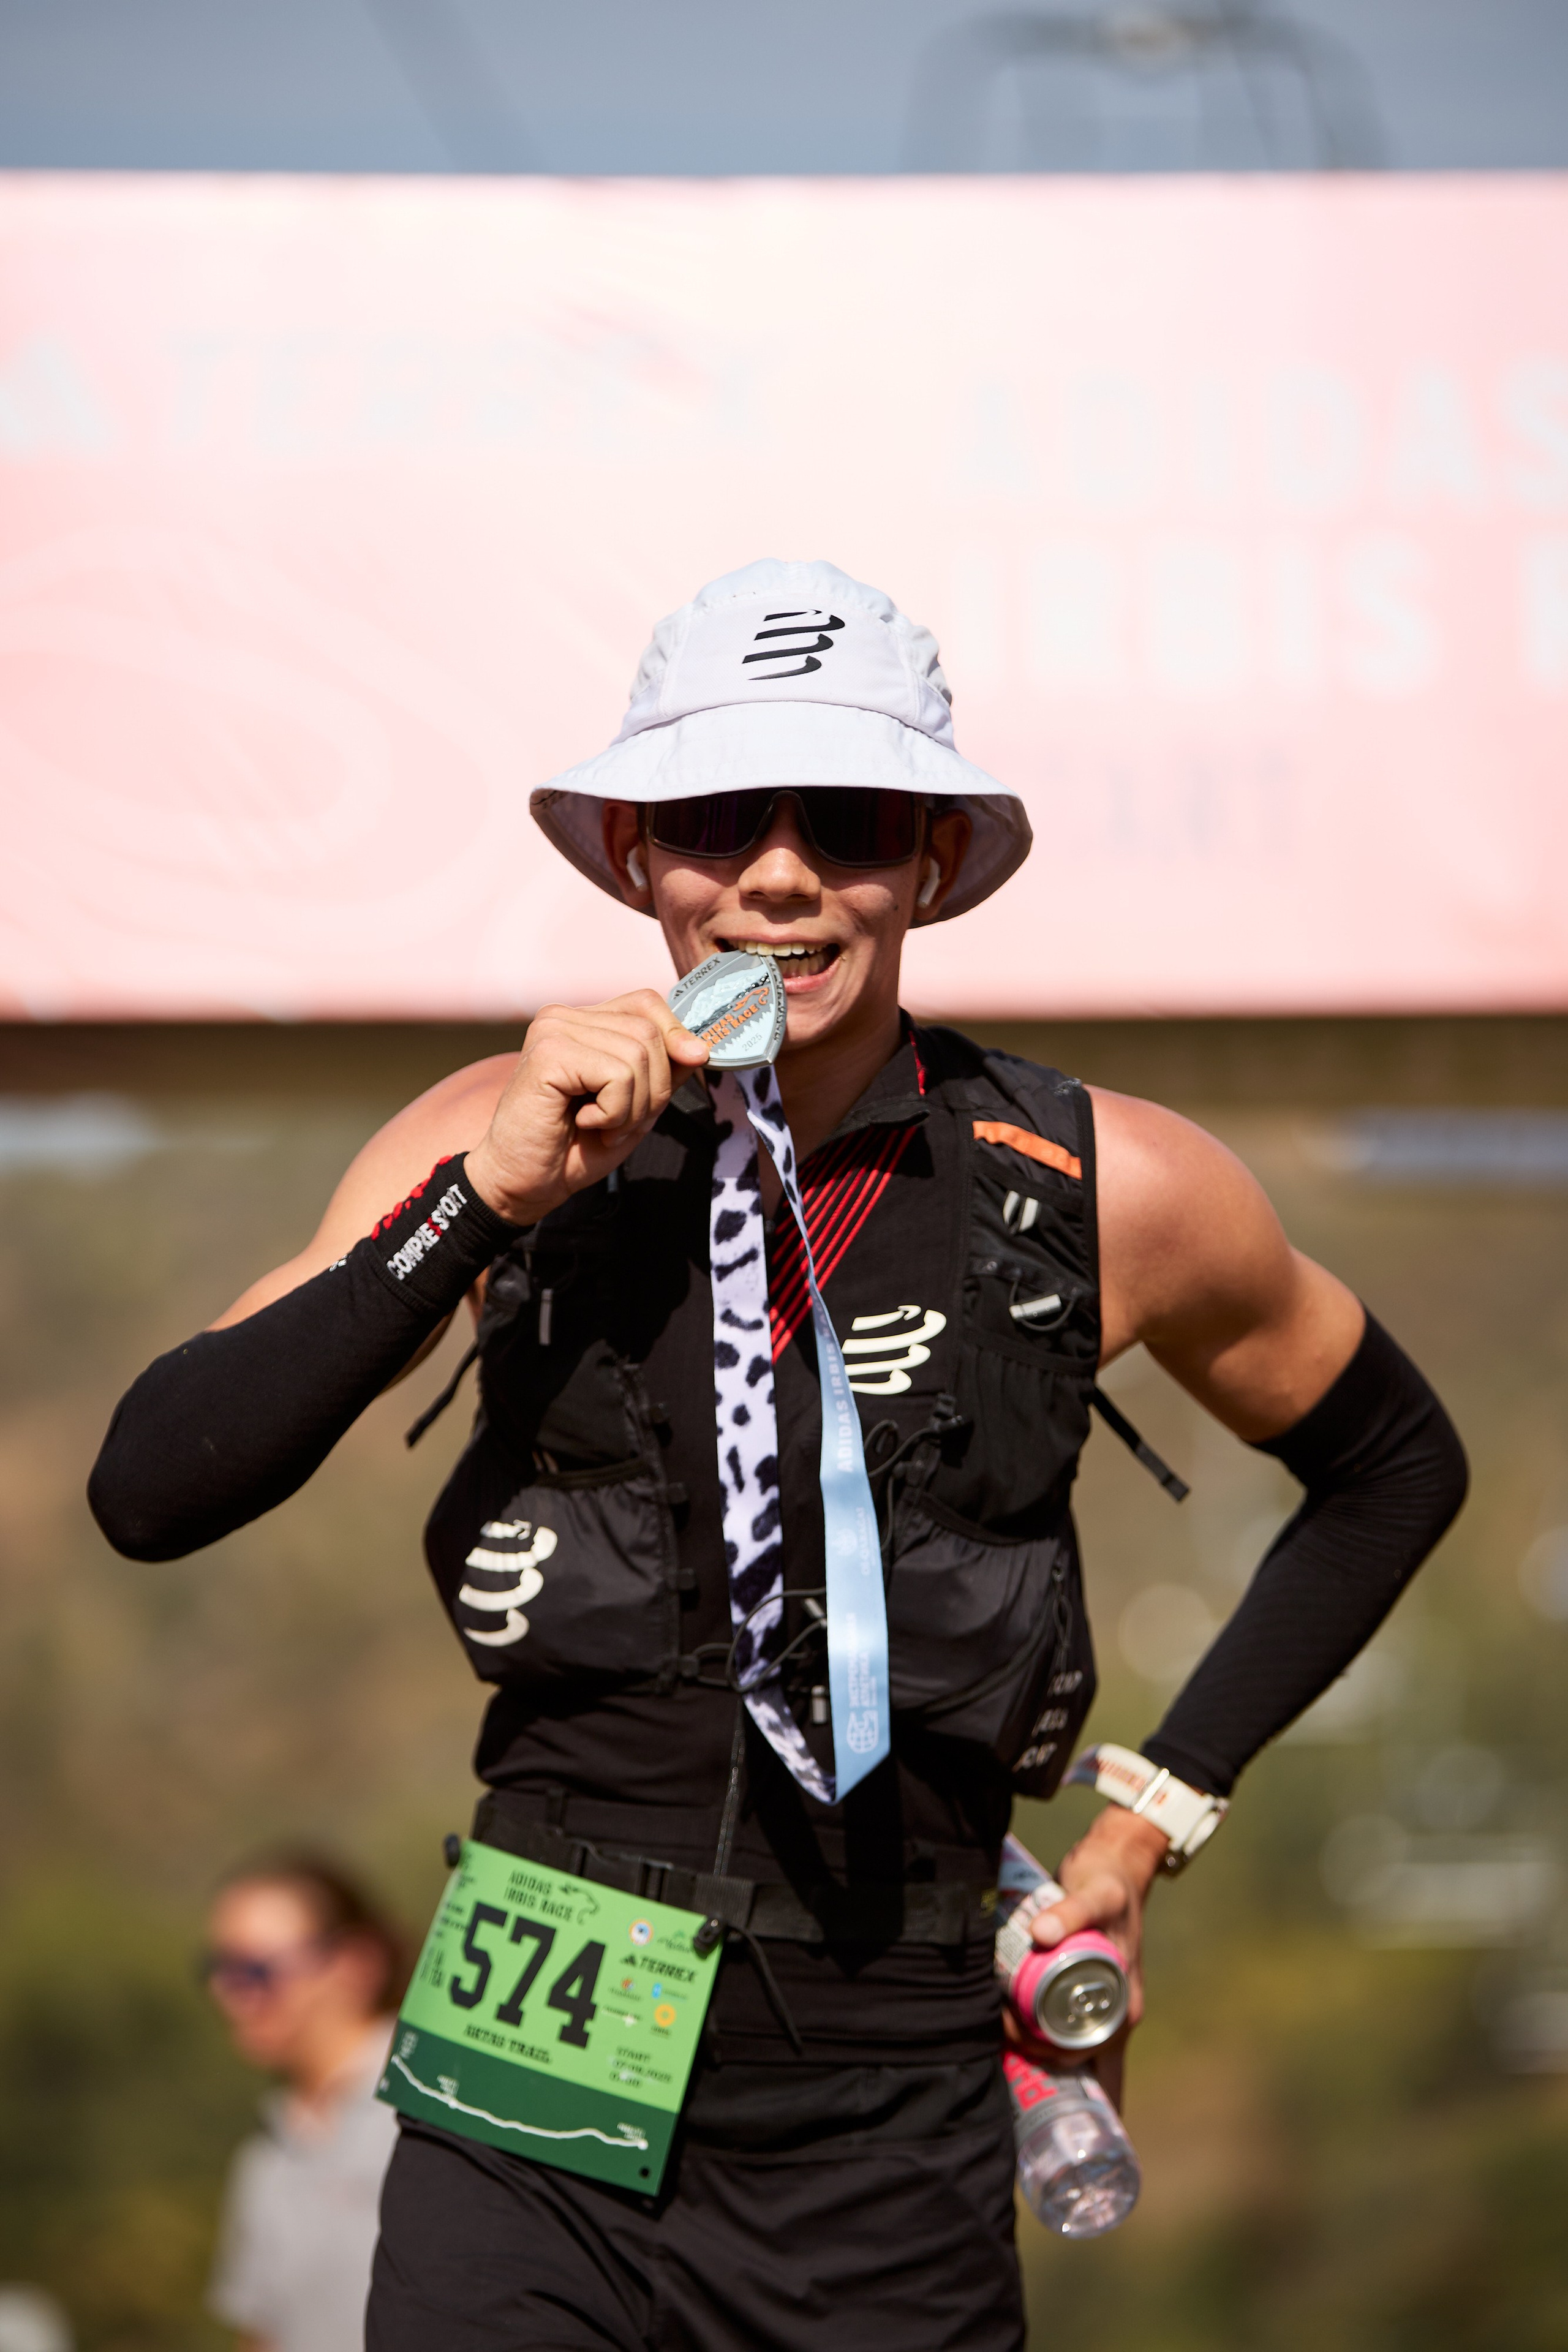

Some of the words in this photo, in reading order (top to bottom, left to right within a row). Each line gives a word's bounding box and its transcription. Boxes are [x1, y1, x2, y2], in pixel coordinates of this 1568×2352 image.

[680, 957, 721, 990] TERREX
[702, 1014, 734, 1041] DIDAS
[706, 1027, 731, 1049] RBIS
[730, 1004, 760, 1029] RACE
[742, 1031, 763, 1052] 2025
[827, 1343, 845, 1395] IRBIS
[837, 1400, 854, 1473] ADIDAS
[507, 1869, 554, 1896] ADIDAS
[450, 1902, 607, 2048] 574
[636, 1954, 697, 1984] TERREX
